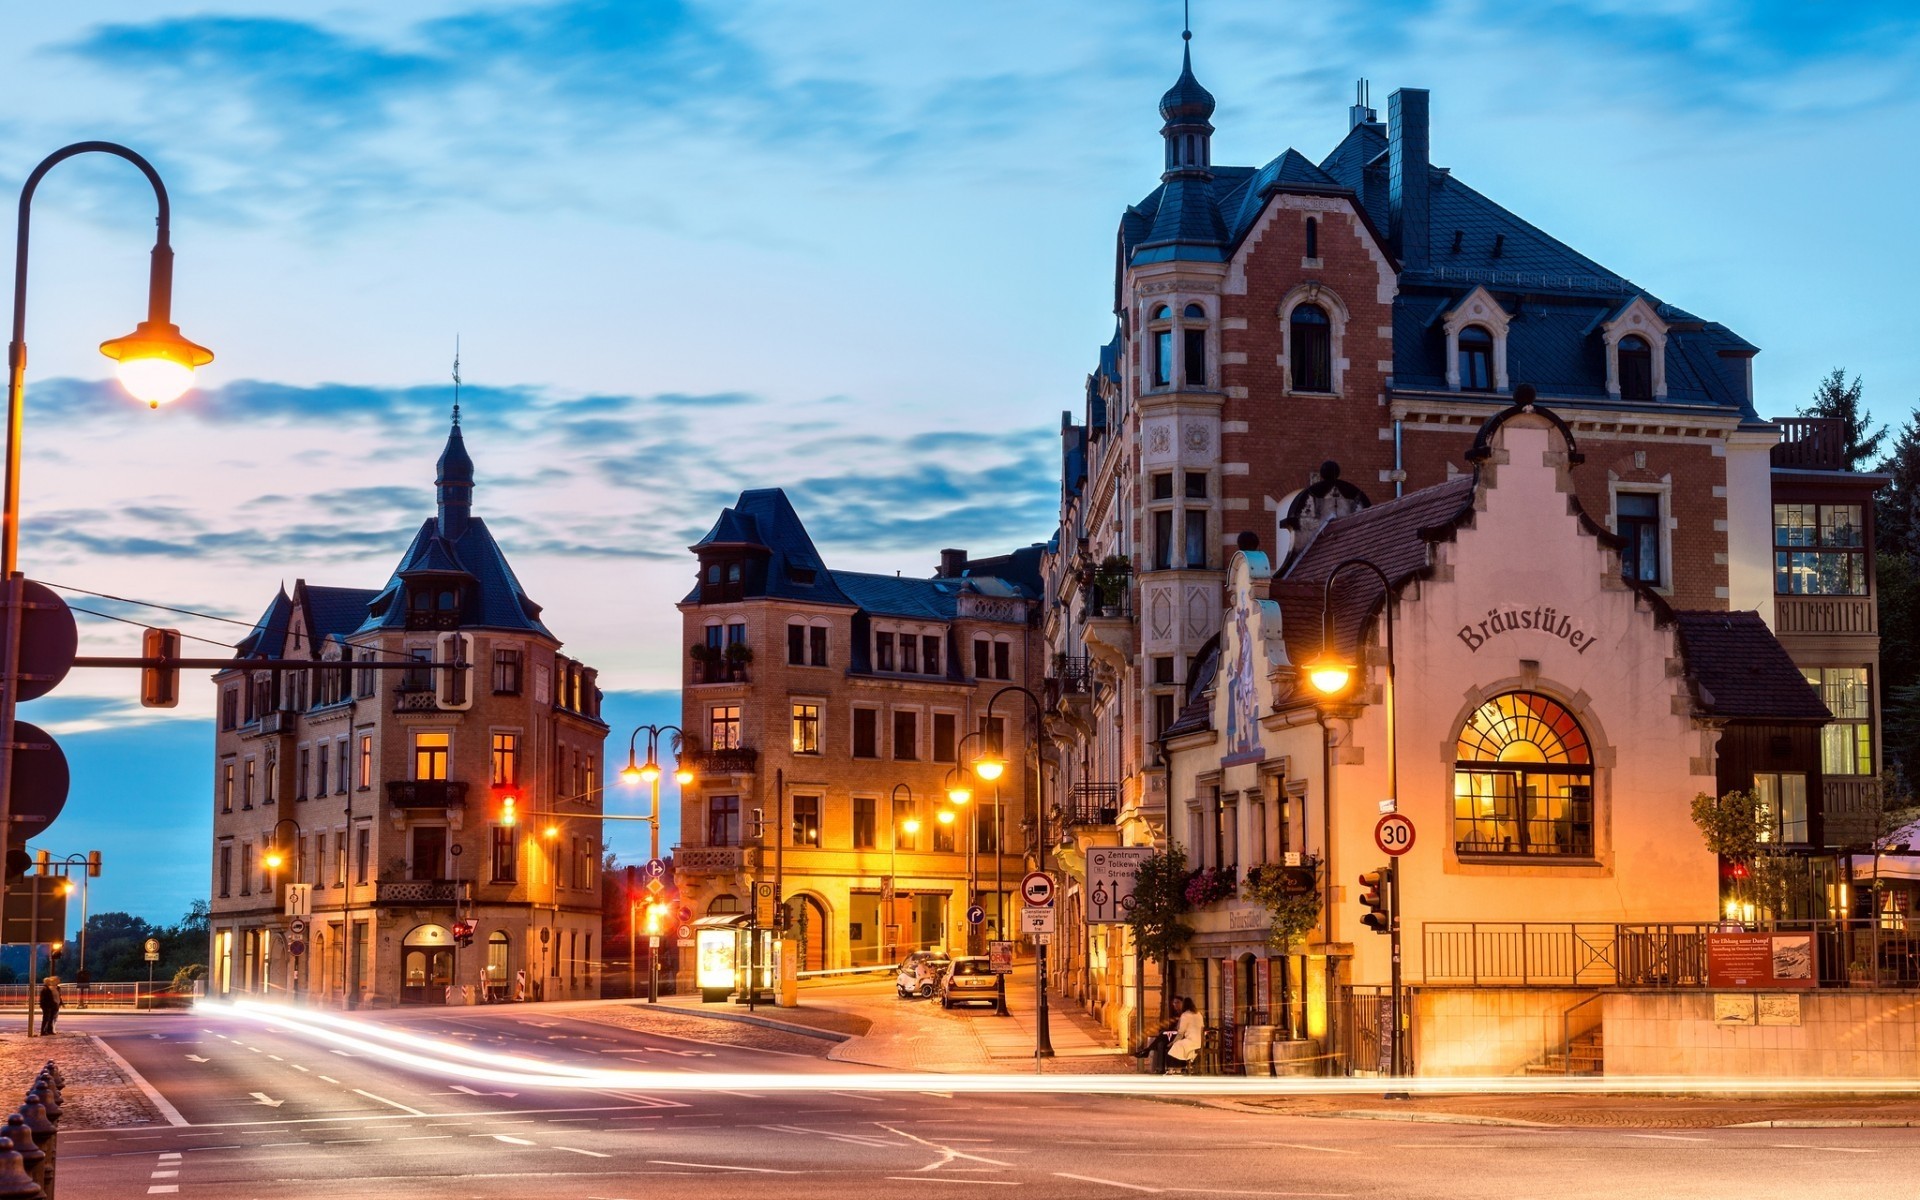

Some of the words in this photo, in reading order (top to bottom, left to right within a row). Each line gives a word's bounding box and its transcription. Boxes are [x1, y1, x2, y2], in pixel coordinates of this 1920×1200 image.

[1457, 606, 1597, 655] Bräustübel
[1383, 825, 1407, 844] 30
[1108, 851, 1140, 859] Zentrum
[1108, 870, 1137, 878] Striese
